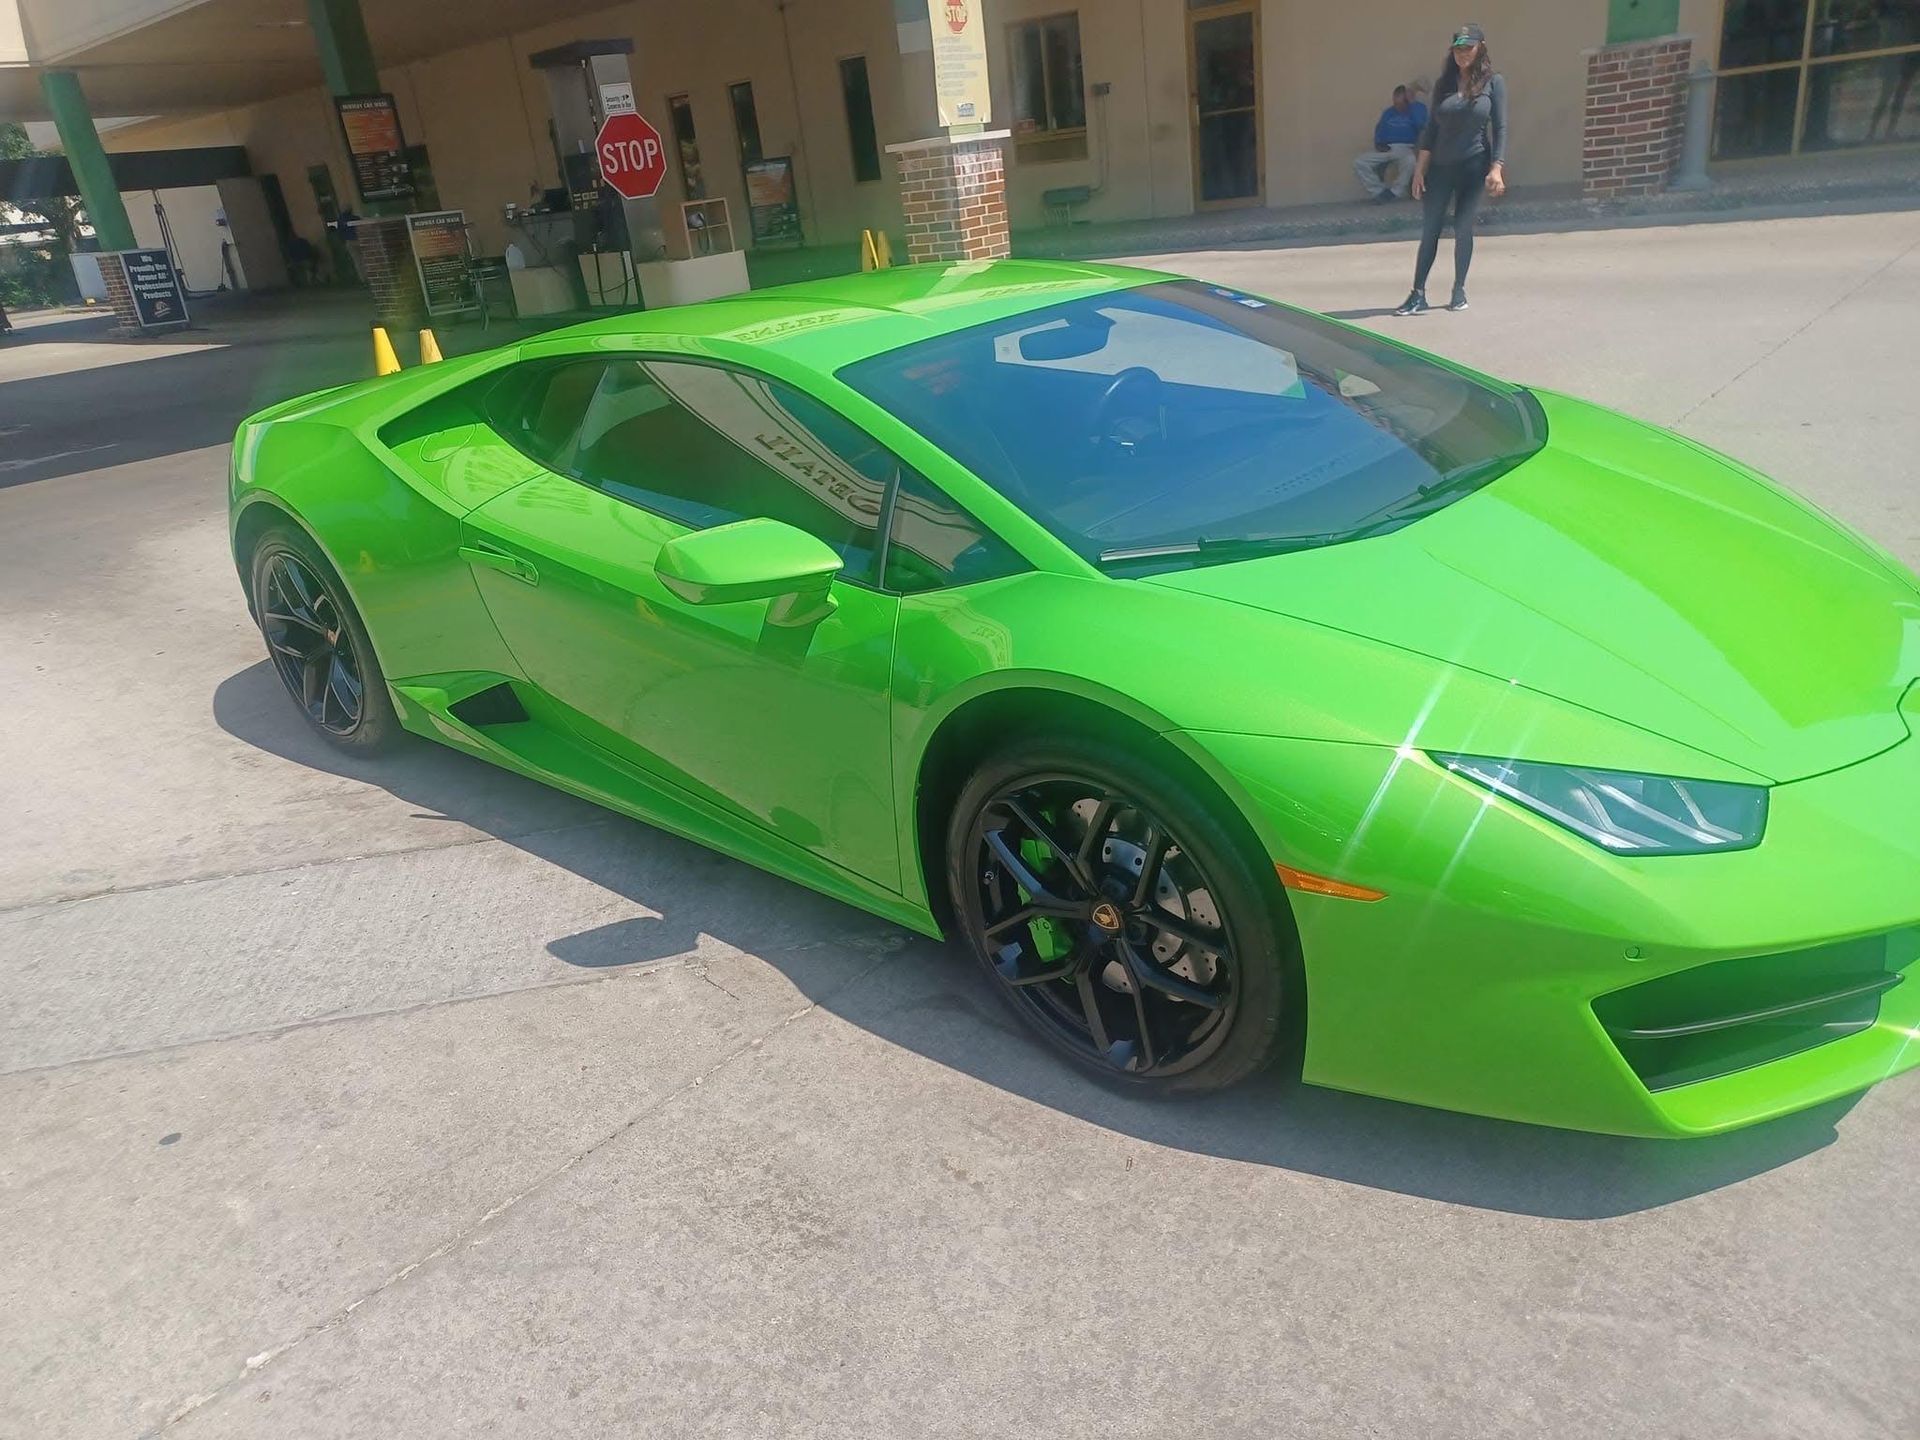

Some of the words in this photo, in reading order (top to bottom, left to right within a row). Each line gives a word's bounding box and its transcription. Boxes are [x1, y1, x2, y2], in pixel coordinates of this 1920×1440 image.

[602, 138, 658, 174] STOP
[129, 264, 155, 272] Proudly
[134, 281, 174, 290] Professional
[143, 291, 172, 299] Products
